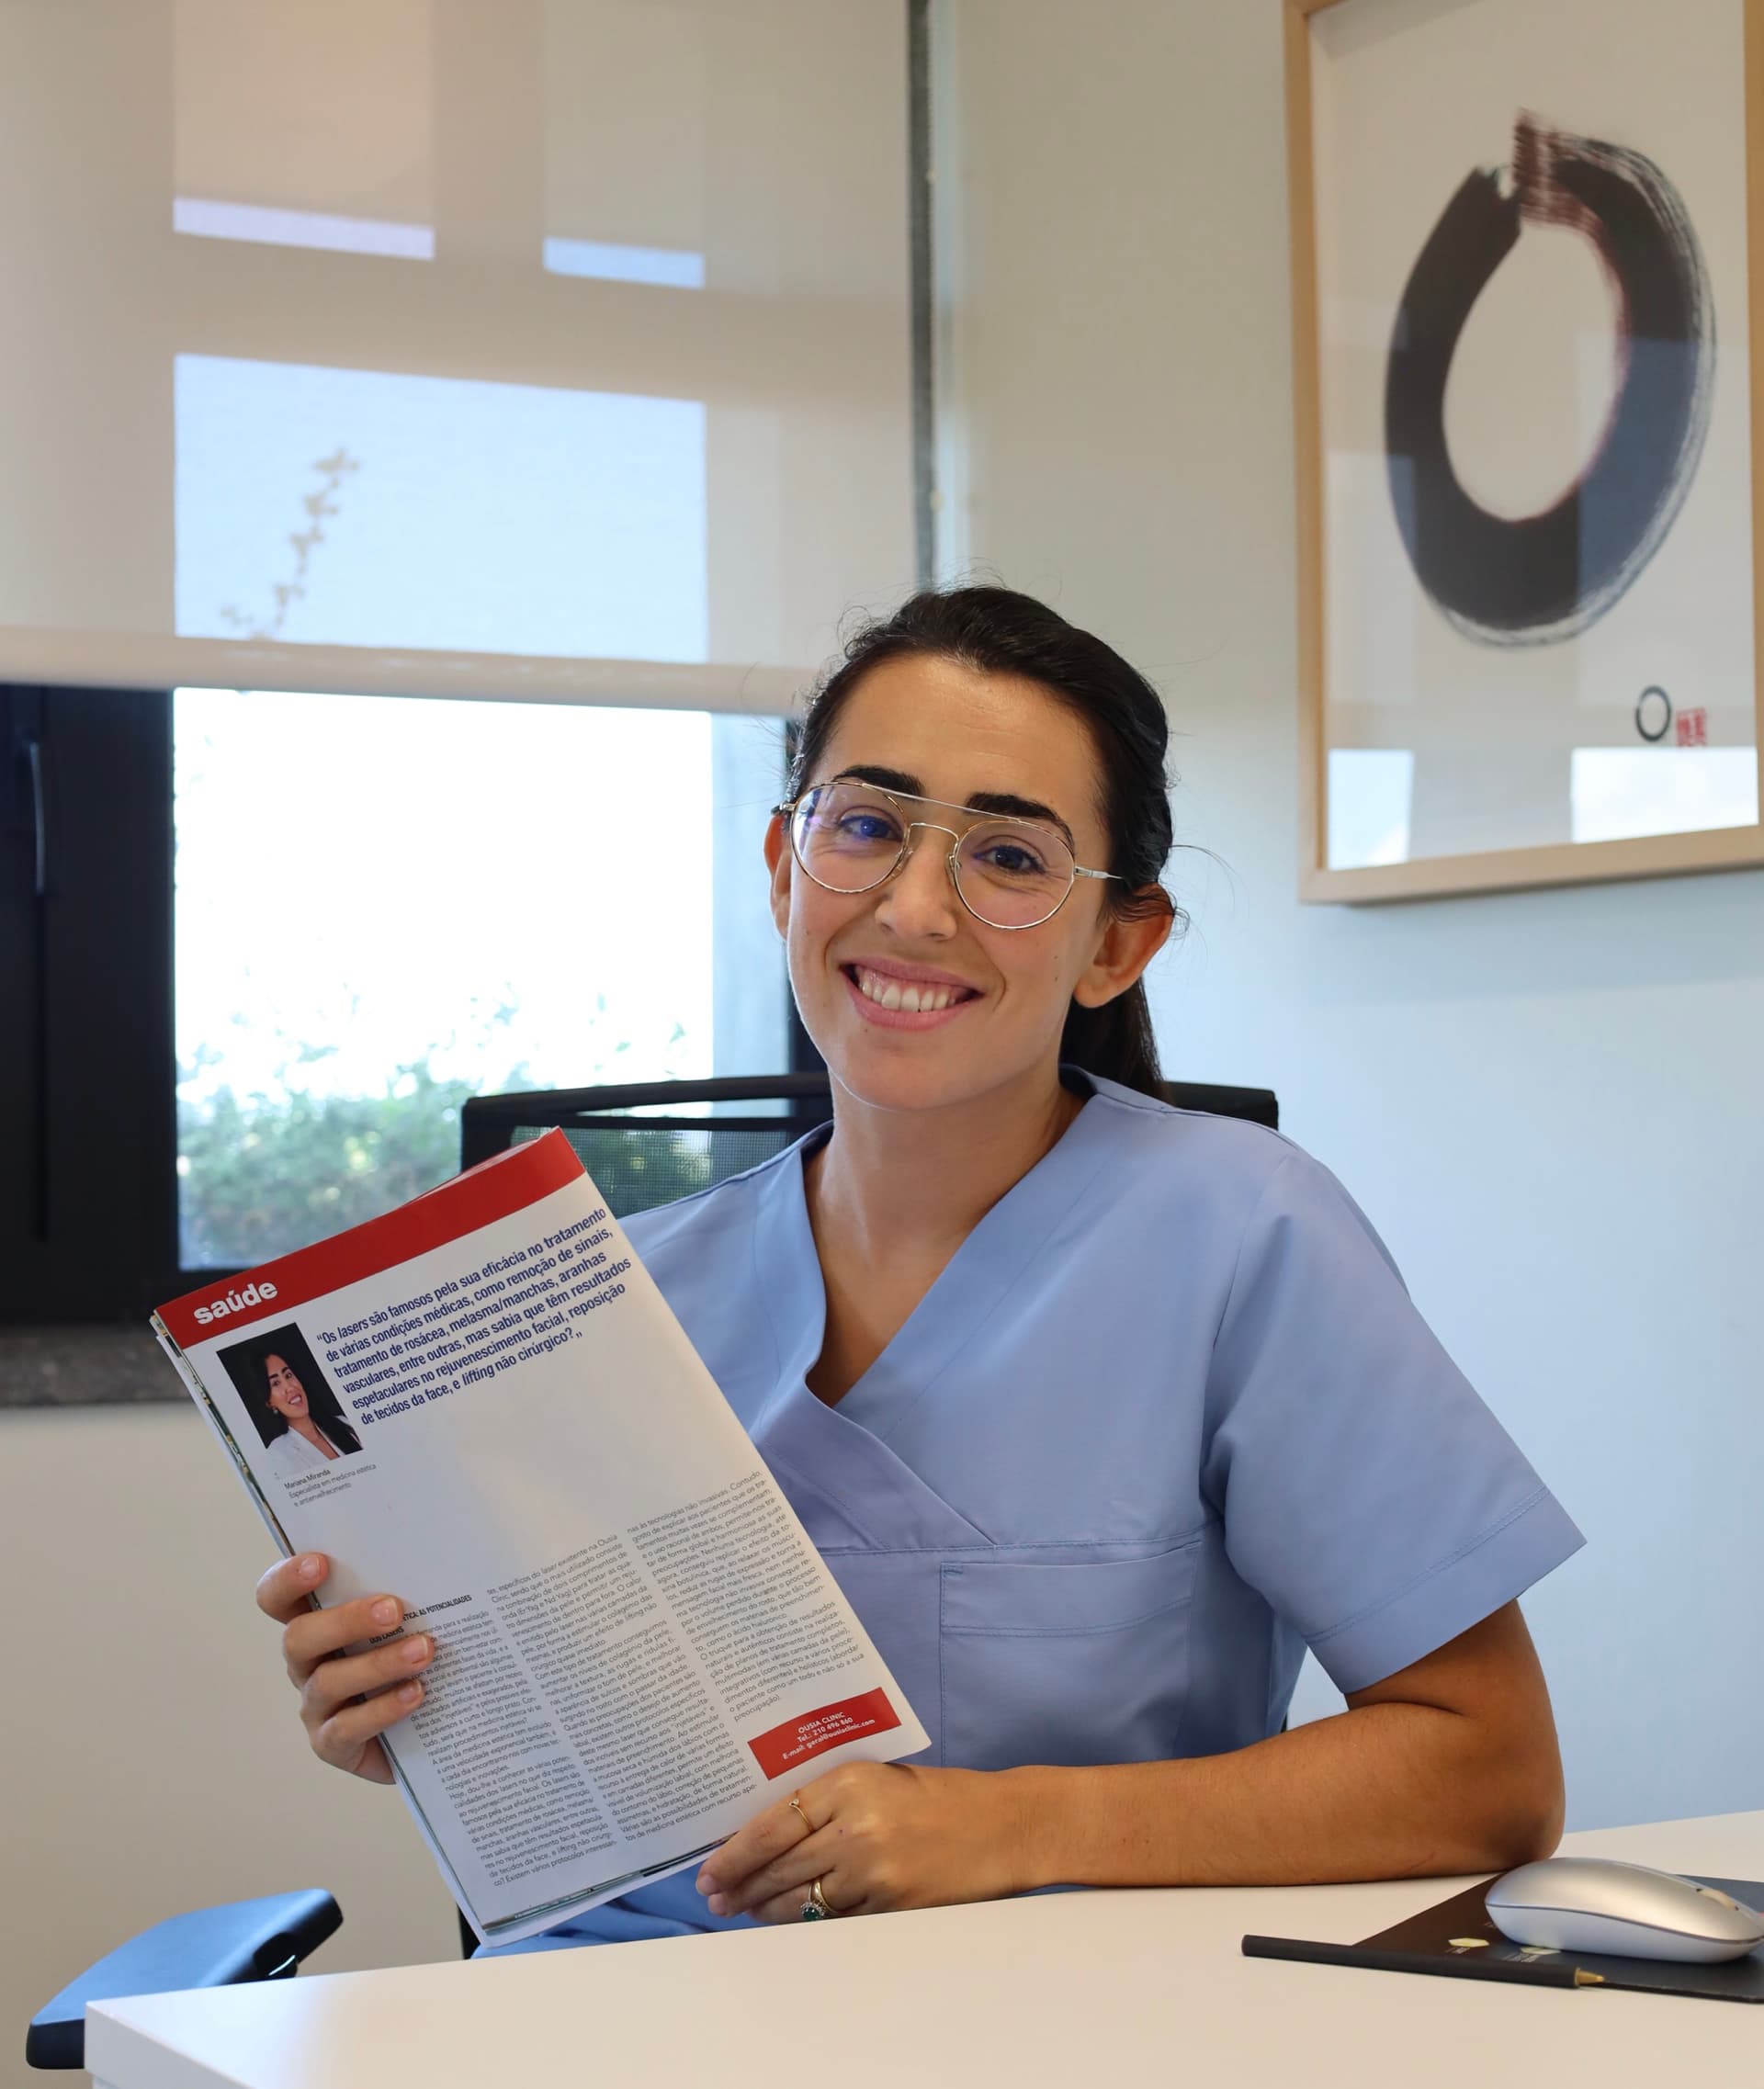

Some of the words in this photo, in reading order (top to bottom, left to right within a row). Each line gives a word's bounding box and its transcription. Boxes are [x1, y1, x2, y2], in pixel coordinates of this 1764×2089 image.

[194, 1282, 277, 1324] saúde
[324, 1349, 340, 1362] de
[339, 1338, 371, 1357] várias
[370, 1316, 423, 1344] condições
[423, 1295, 474, 1323] médicas,
[473, 1280, 505, 1301] como
[505, 1257, 557, 1286] remoção
[556, 1248, 574, 1263] de
[574, 1229, 613, 1255] sinais,
[334, 1349, 390, 1378] tratamento
[388, 1344, 404, 1357] de
[403, 1327, 449, 1351] rosácea,
[449, 1278, 559, 1332] melasma/manchas,
[558, 1252, 606, 1282] aranhas
[335, 1319, 369, 1338] lasers
[368, 1311, 389, 1326] são
[387, 1292, 433, 1317] famosos
[433, 1281, 458, 1301] pela
[458, 1270, 481, 1287] sua
[481, 1250, 526, 1277] eficácia
[526, 1242, 543, 1257] no
[542, 1210, 606, 1248] tratamento
[344, 1367, 400, 1395] vasculares,
[399, 1355, 426, 1372] entre
[426, 1339, 466, 1361] outras,
[465, 1327, 491, 1345] mas
[491, 1314, 523, 1334] sabia
[523, 1303, 546, 1322] que
[545, 1291, 570, 1309] têm
[571, 1259, 631, 1297] resultados
[352, 1376, 420, 1410] espetaculares
[420, 1371, 435, 1383] no
[435, 1329, 533, 1377] rejuvenescimento
[531, 1311, 569, 1335] facial,
[568, 1284, 626, 1319] reposição
[360, 1414, 375, 1426] de
[373, 1400, 411, 1421] tecidos
[409, 1394, 425, 1406] da
[424, 1384, 453, 1401] face,
[452, 1380, 461, 1390] e
[460, 1365, 496, 1386] lifting
[494, 1355, 517, 1372] não
